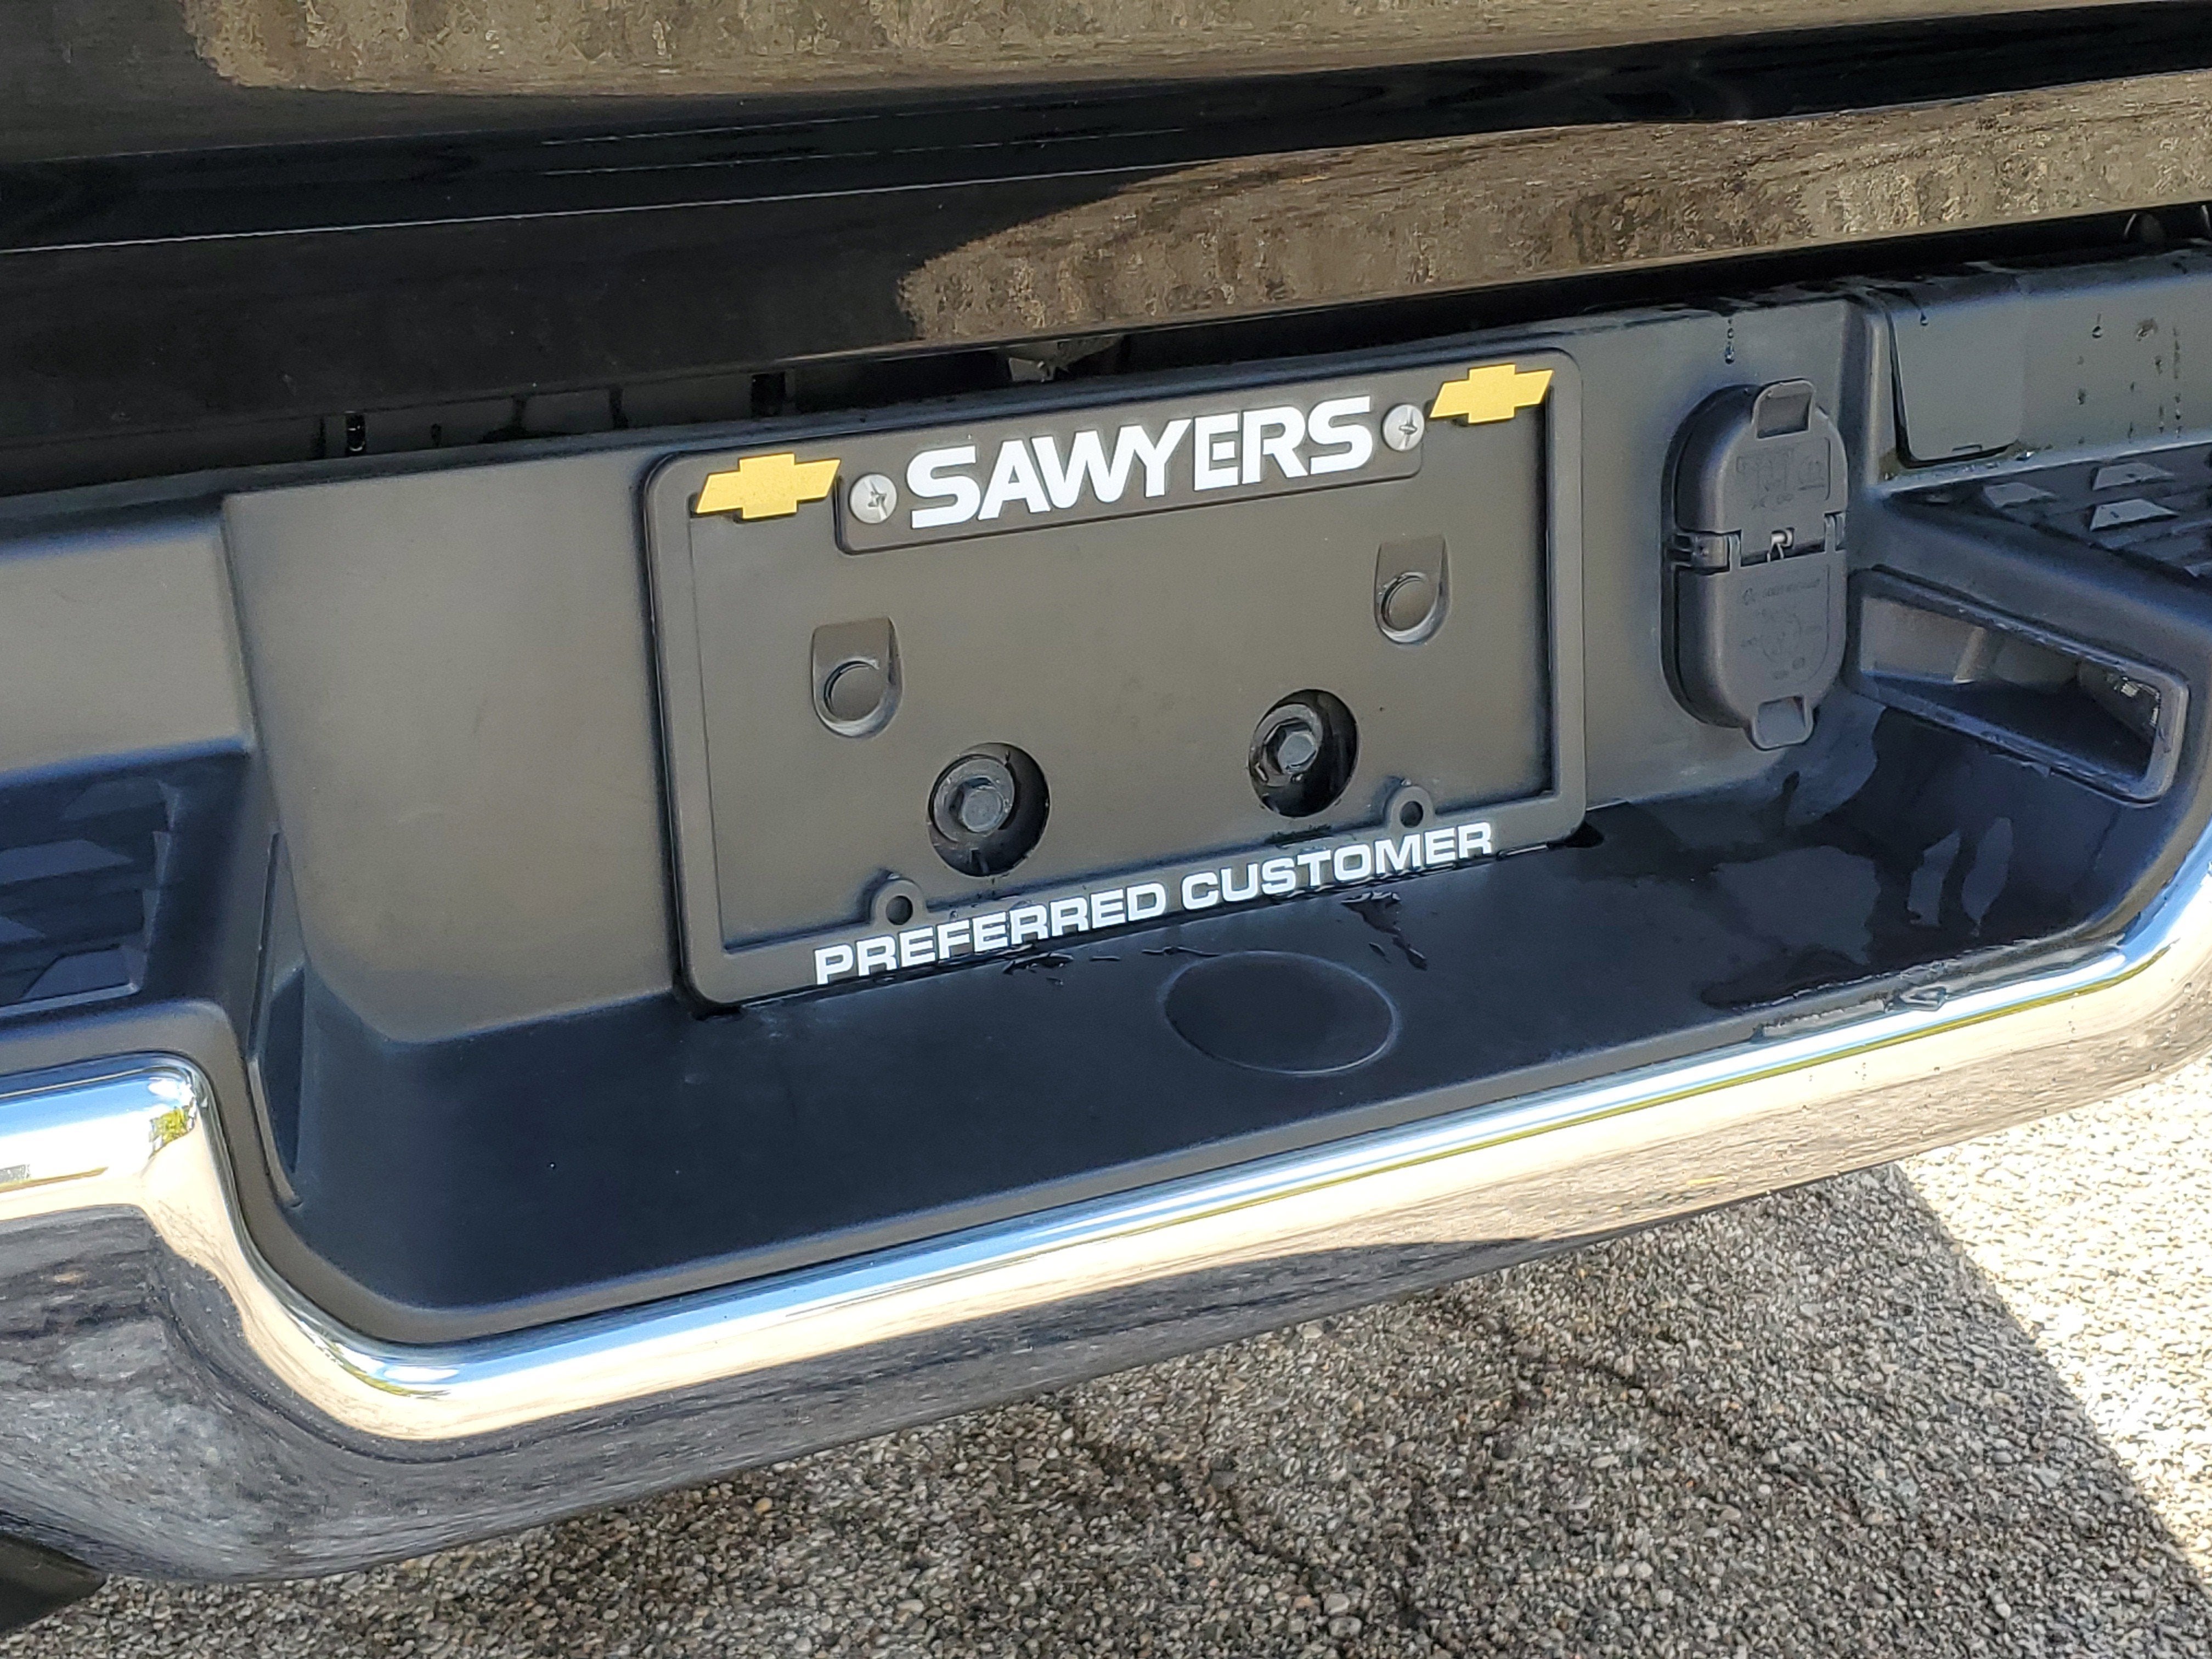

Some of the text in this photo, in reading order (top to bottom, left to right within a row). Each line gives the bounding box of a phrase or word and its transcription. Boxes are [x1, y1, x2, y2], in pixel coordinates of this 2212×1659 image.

[906, 395, 1374, 528] SAWYERS
[814, 821, 1494, 985] PREFERRED CUSTOMER
